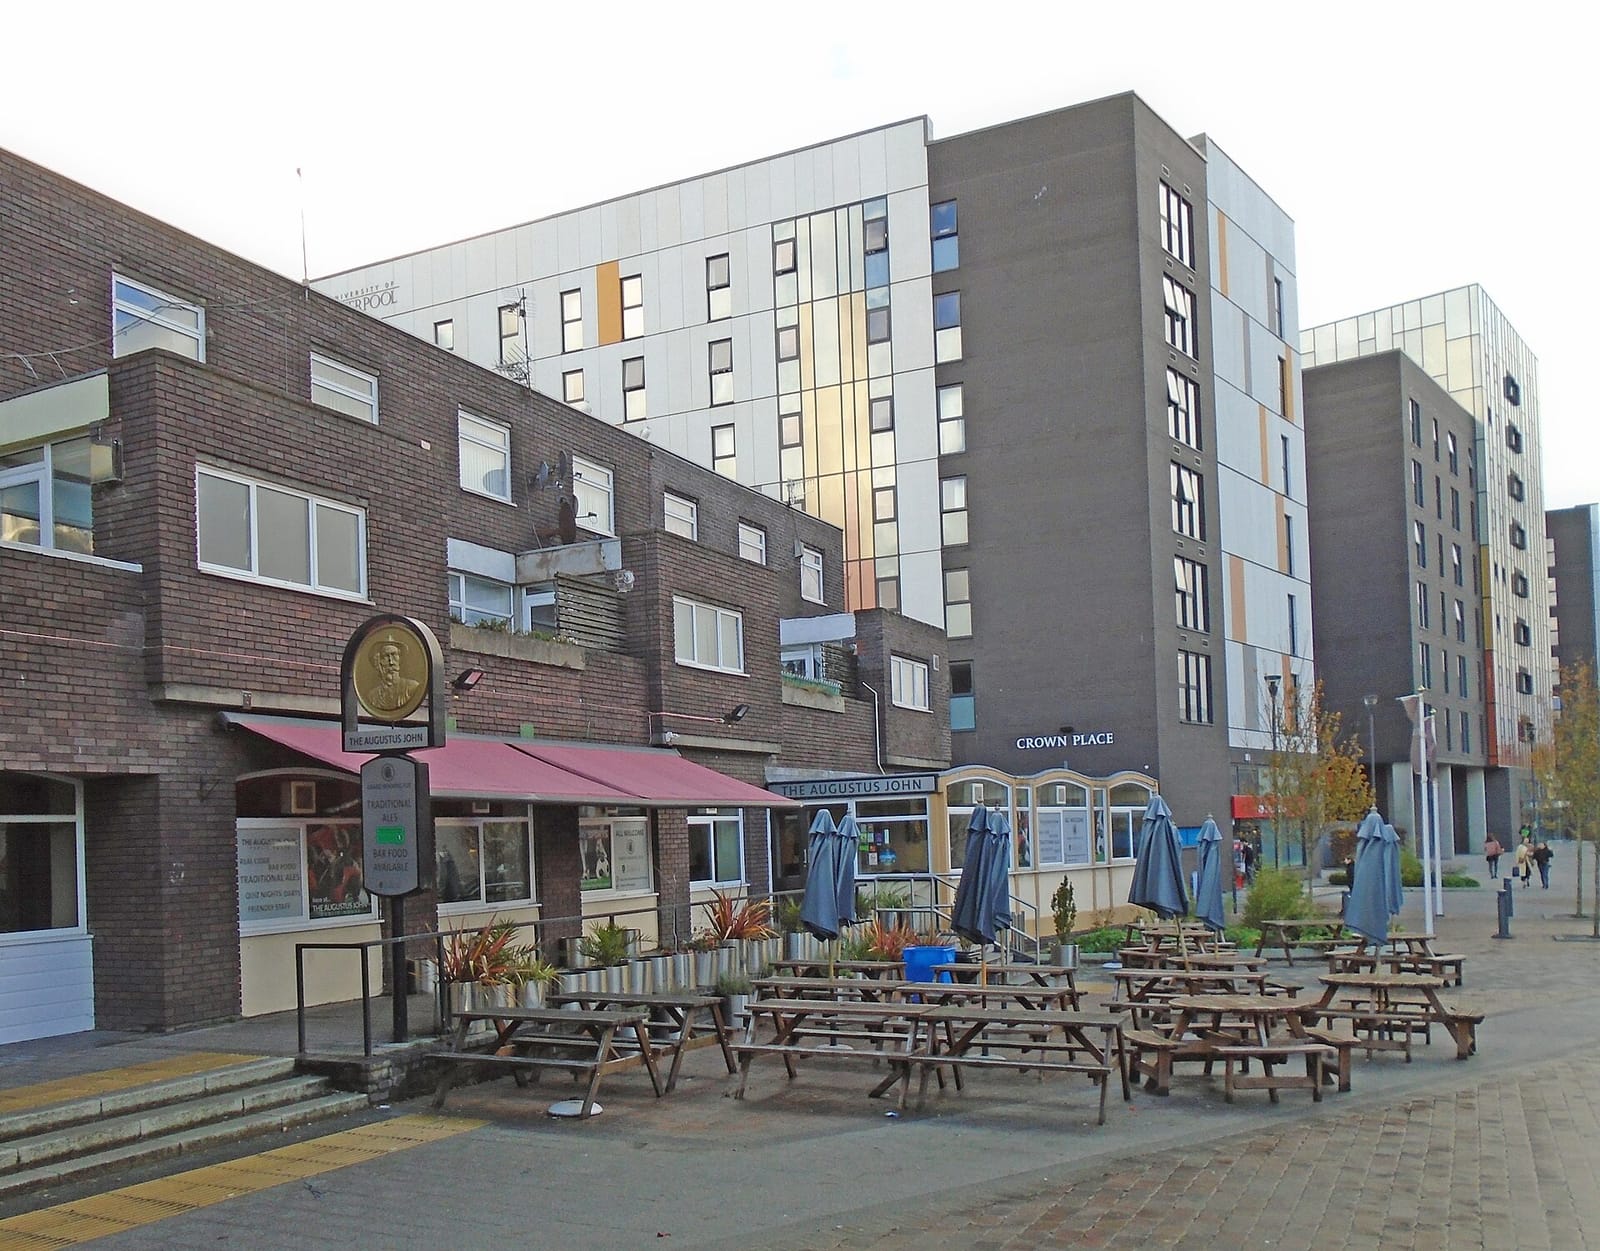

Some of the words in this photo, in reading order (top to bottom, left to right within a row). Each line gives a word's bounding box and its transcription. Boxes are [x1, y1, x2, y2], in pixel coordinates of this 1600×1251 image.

[349, 736, 362, 746] THE
[364, 734, 402, 745] AUGUSTUS
[403, 733, 423, 743] JOHN
[1016, 736, 1067, 749] CROWN
[1072, 732, 1114, 746] PLACE
[782, 785, 805, 796] THE
[810, 781, 880, 795] AUGUSTUS
[884, 779, 921, 792] JOHN
[367, 800, 412, 809] TRADITIONAL
[382, 813, 399, 823] ALES
[373, 848, 386, 858] BAR
[388, 848, 408, 858] FOOD
[373, 863, 409, 872] AVAILABLE
[240, 874, 284, 884] TRADITIONAL
[312, 904, 324, 912] THE
[324, 902, 353, 912] AUGUSTUS
